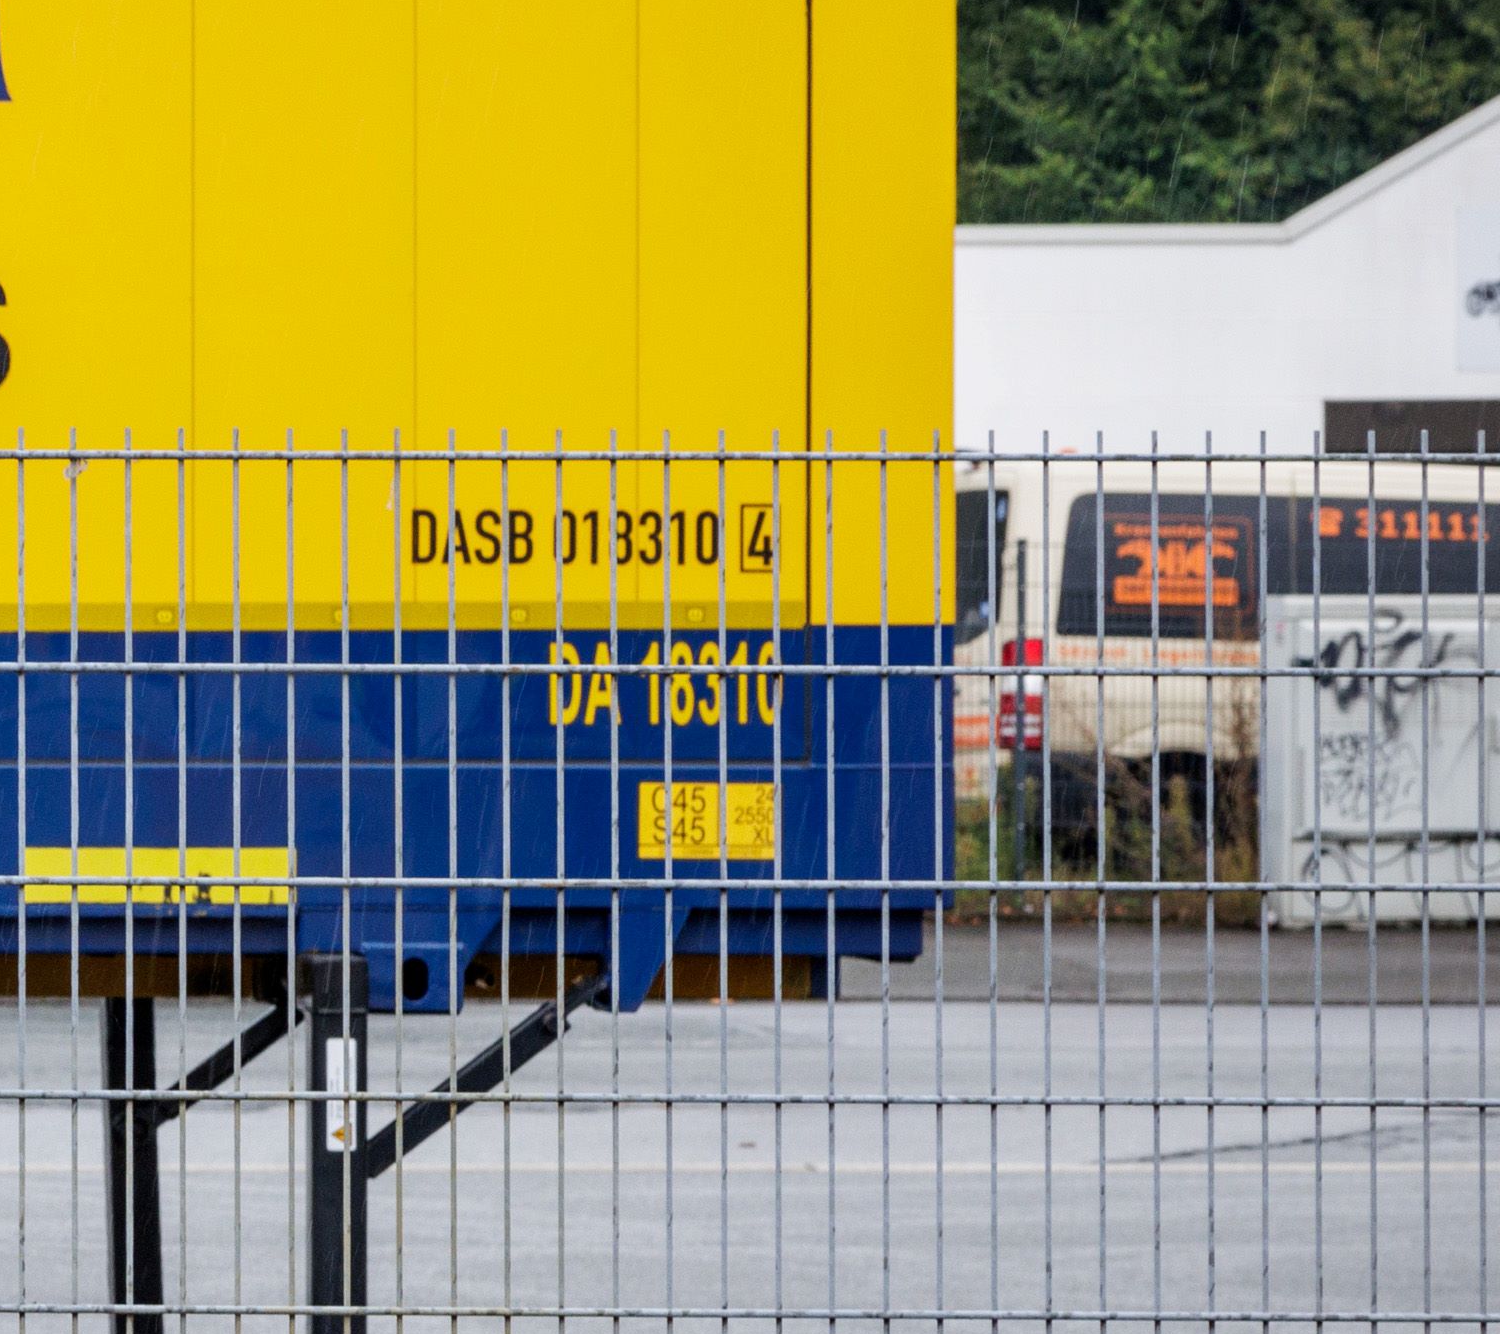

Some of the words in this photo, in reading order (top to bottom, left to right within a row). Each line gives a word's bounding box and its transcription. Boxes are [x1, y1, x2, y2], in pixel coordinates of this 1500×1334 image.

[411, 510, 534, 565] DASB
[552, 510, 721, 566] 018310
[747, 509, 775, 568] 4
[549, 641, 622, 726] DA
[641, 639, 785, 726] 18310
[653, 817, 706, 845] S45
